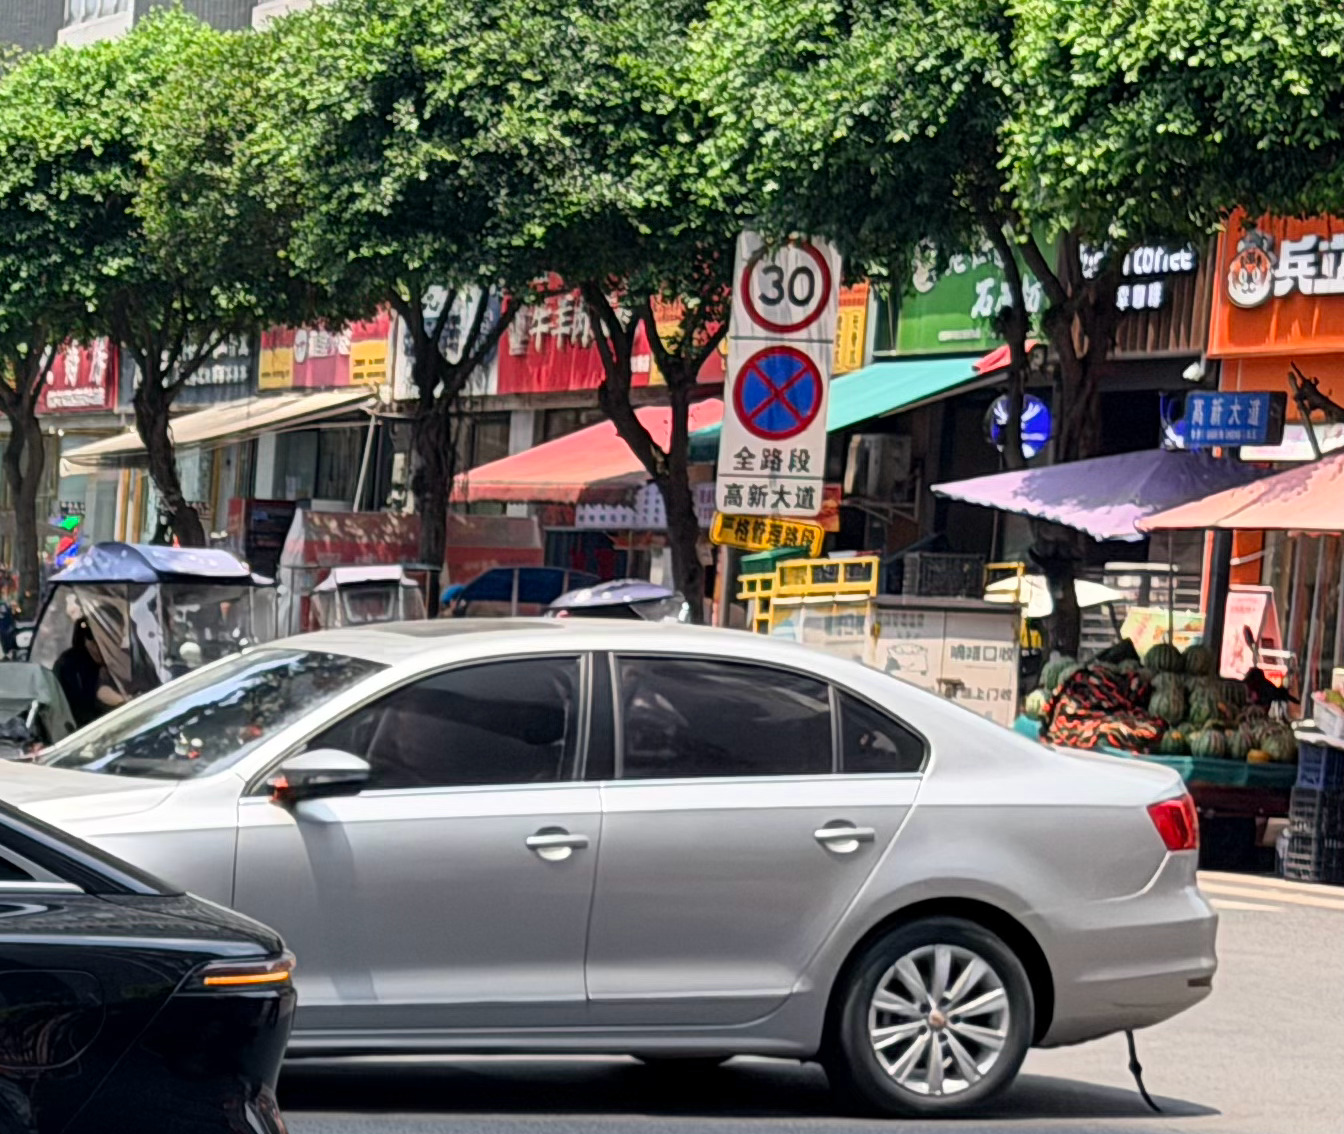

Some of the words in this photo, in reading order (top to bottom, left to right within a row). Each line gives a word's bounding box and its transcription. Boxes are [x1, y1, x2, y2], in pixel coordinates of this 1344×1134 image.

[759, 265, 815, 307] 30
[1191, 395, 1260, 426] 高新大道
[733, 446, 811, 473] 全路段
[723, 483, 816, 511] 高新大道
